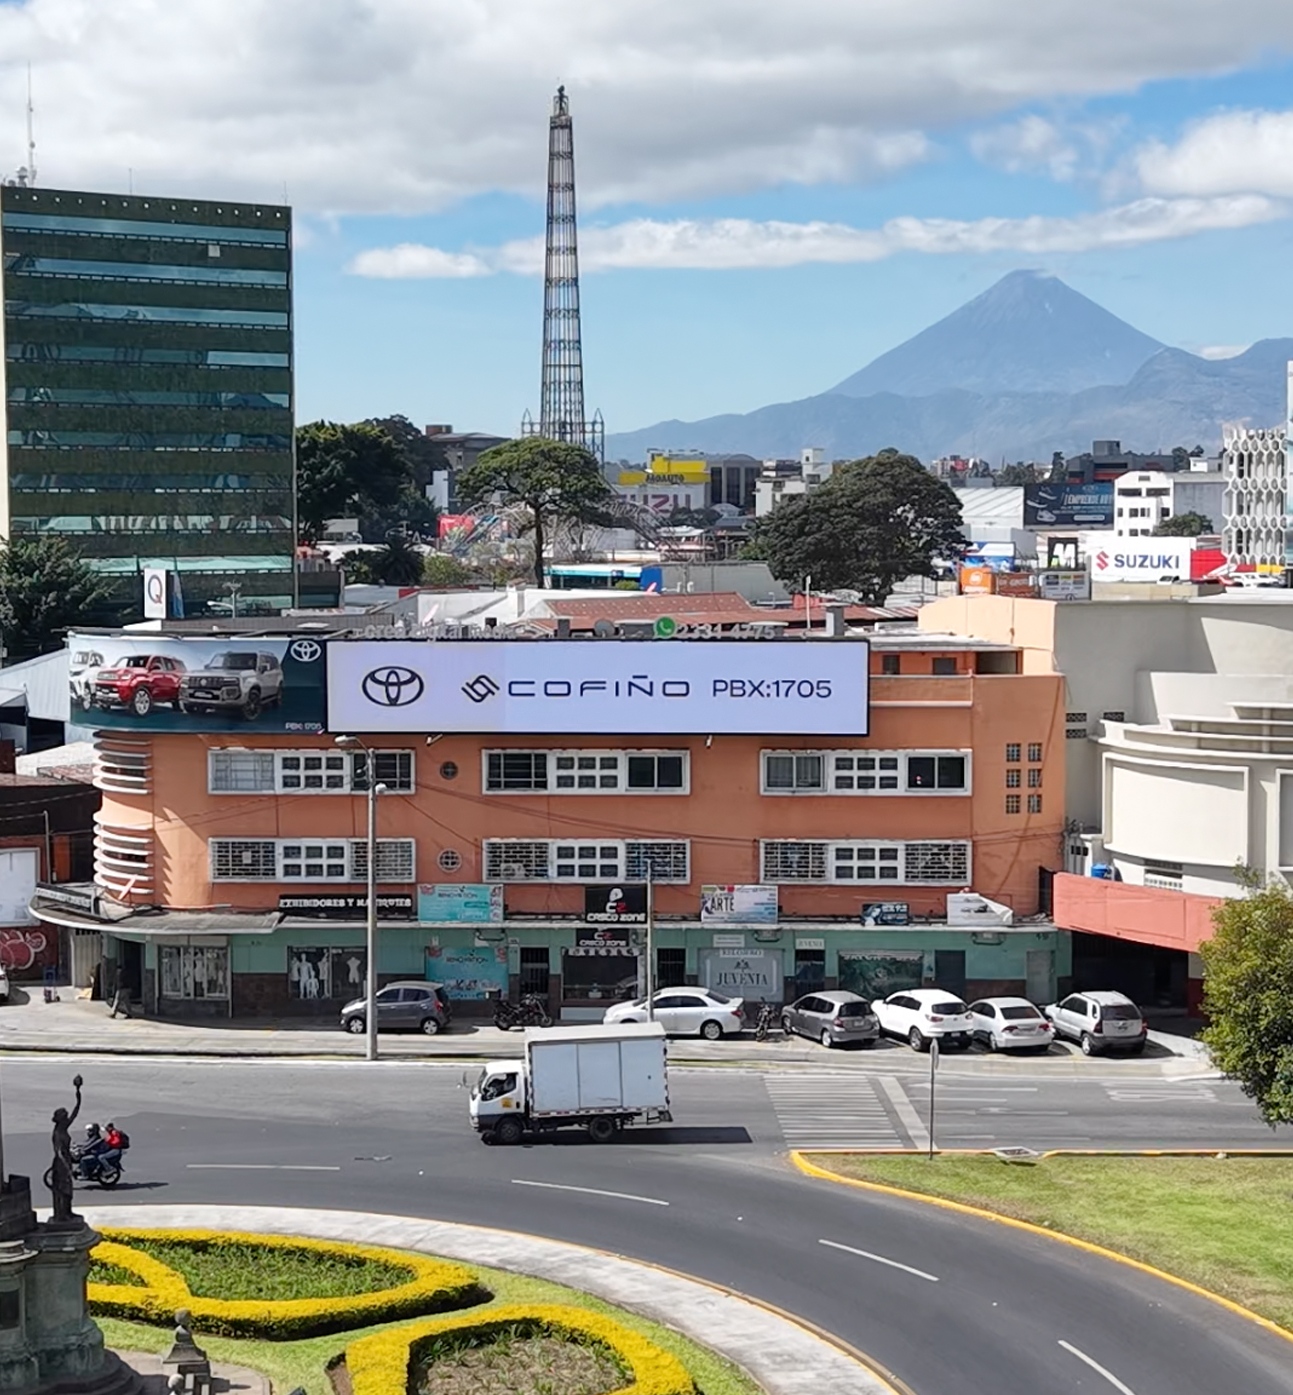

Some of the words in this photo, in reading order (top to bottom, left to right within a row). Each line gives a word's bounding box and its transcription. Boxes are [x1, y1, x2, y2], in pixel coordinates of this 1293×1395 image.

[1114, 554, 1179, 569] SUZUKI
[508, 675, 690, 697] COFIÑO
[713, 680, 832, 698] PBX:1705
[279, 899, 345, 908] EXHIBIDORES
[347, 898, 355, 907] Y
[357, 898, 412, 907] MAIQUIES
